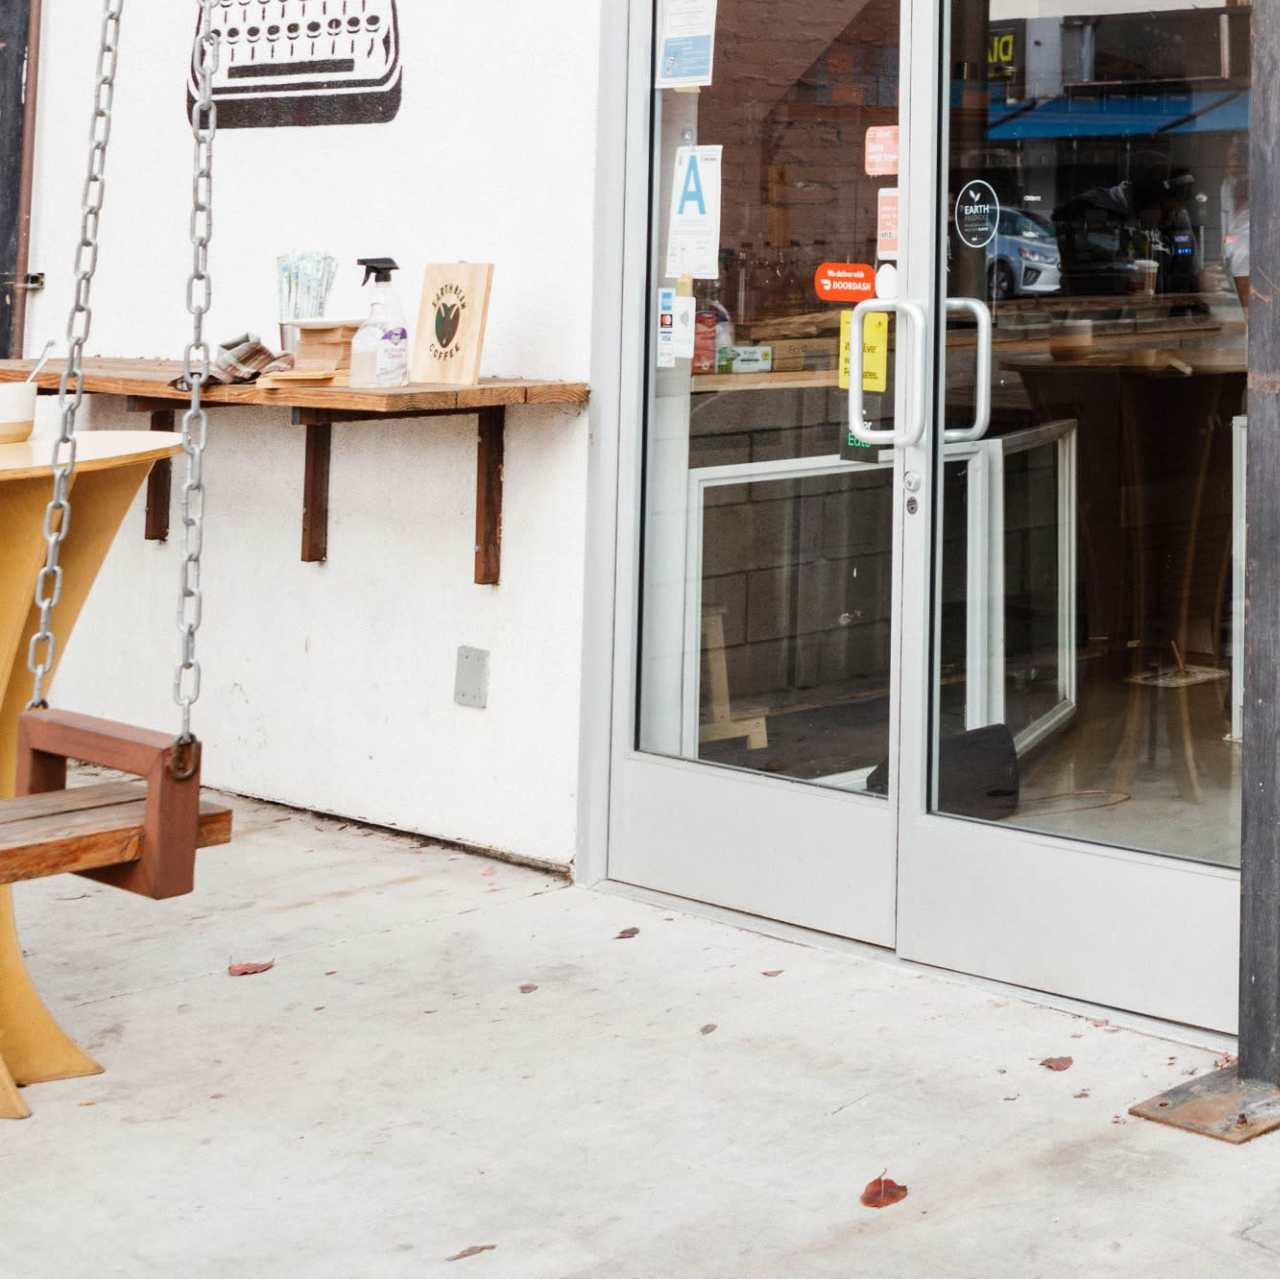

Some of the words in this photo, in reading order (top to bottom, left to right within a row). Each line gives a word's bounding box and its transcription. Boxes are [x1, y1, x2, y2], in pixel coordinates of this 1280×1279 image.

[677, 155, 707, 215] A
[964, 204, 990, 216] EARTH
[832, 281, 872, 292] DOORDASH
